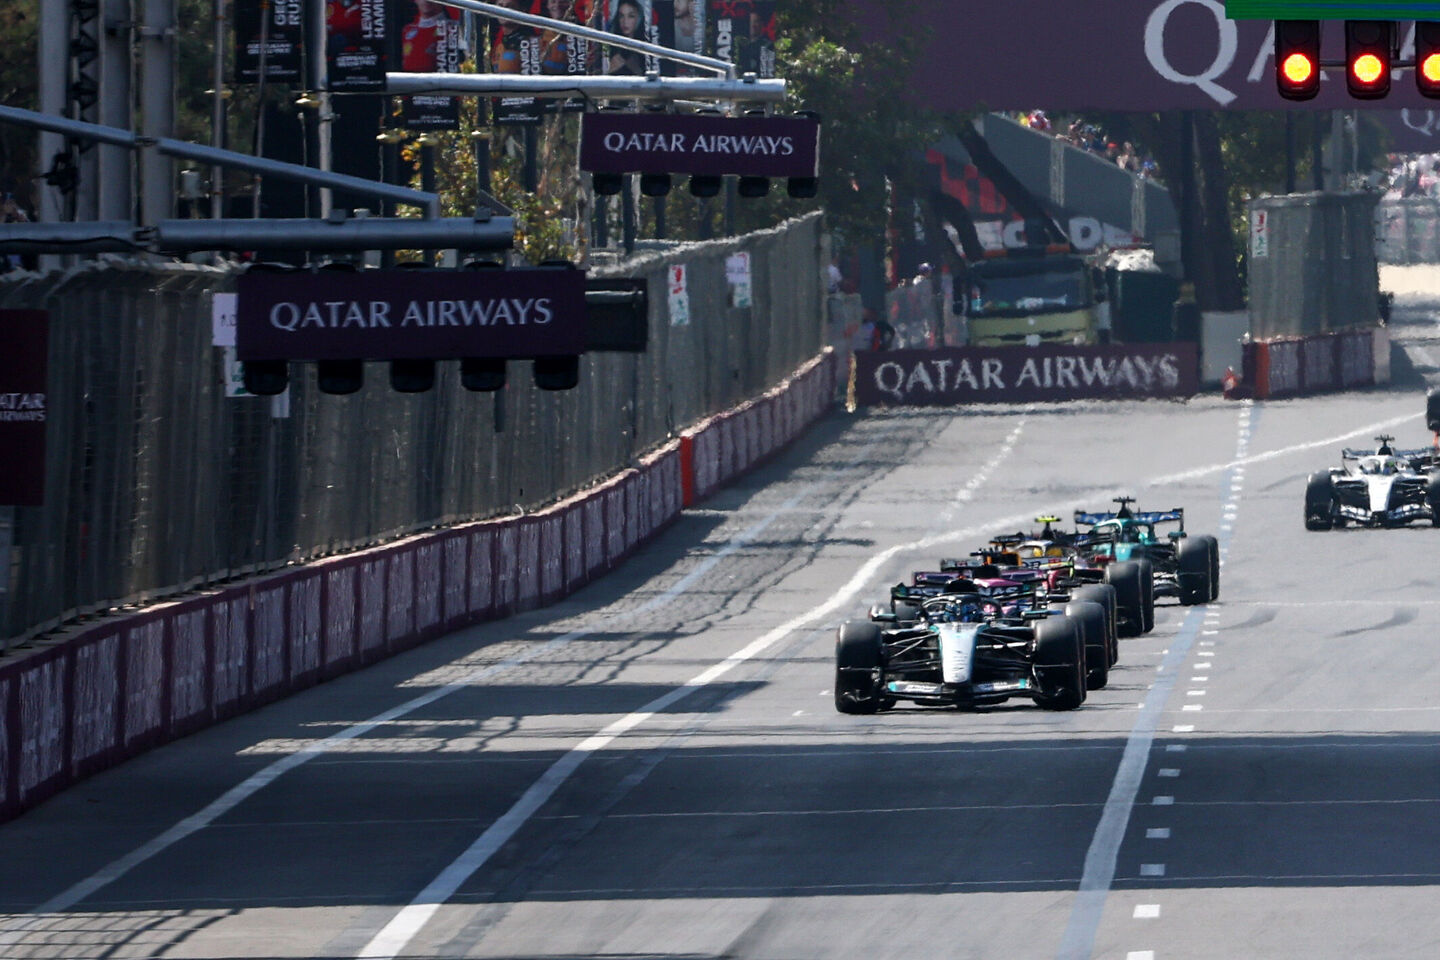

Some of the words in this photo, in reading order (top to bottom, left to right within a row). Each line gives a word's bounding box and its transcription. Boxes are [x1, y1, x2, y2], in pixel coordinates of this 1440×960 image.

[436, 19, 447, 72] HARLES
[447, 23, 458, 73] ECLERC
[520, 40, 530, 75] ANDO
[531, 37, 540, 75] ORRIS
[717, 18, 732, 61] ADE
[603, 131, 686, 153] QATAR
[691, 135, 794, 156] AIRWAYS
[269, 300, 392, 332] QATAR
[400, 297, 554, 328] AIRWAYS
[873, 358, 1006, 398] QATAR
[1014, 353, 1179, 390] AIRWAYS
[0, 393, 46, 410] ATAR
